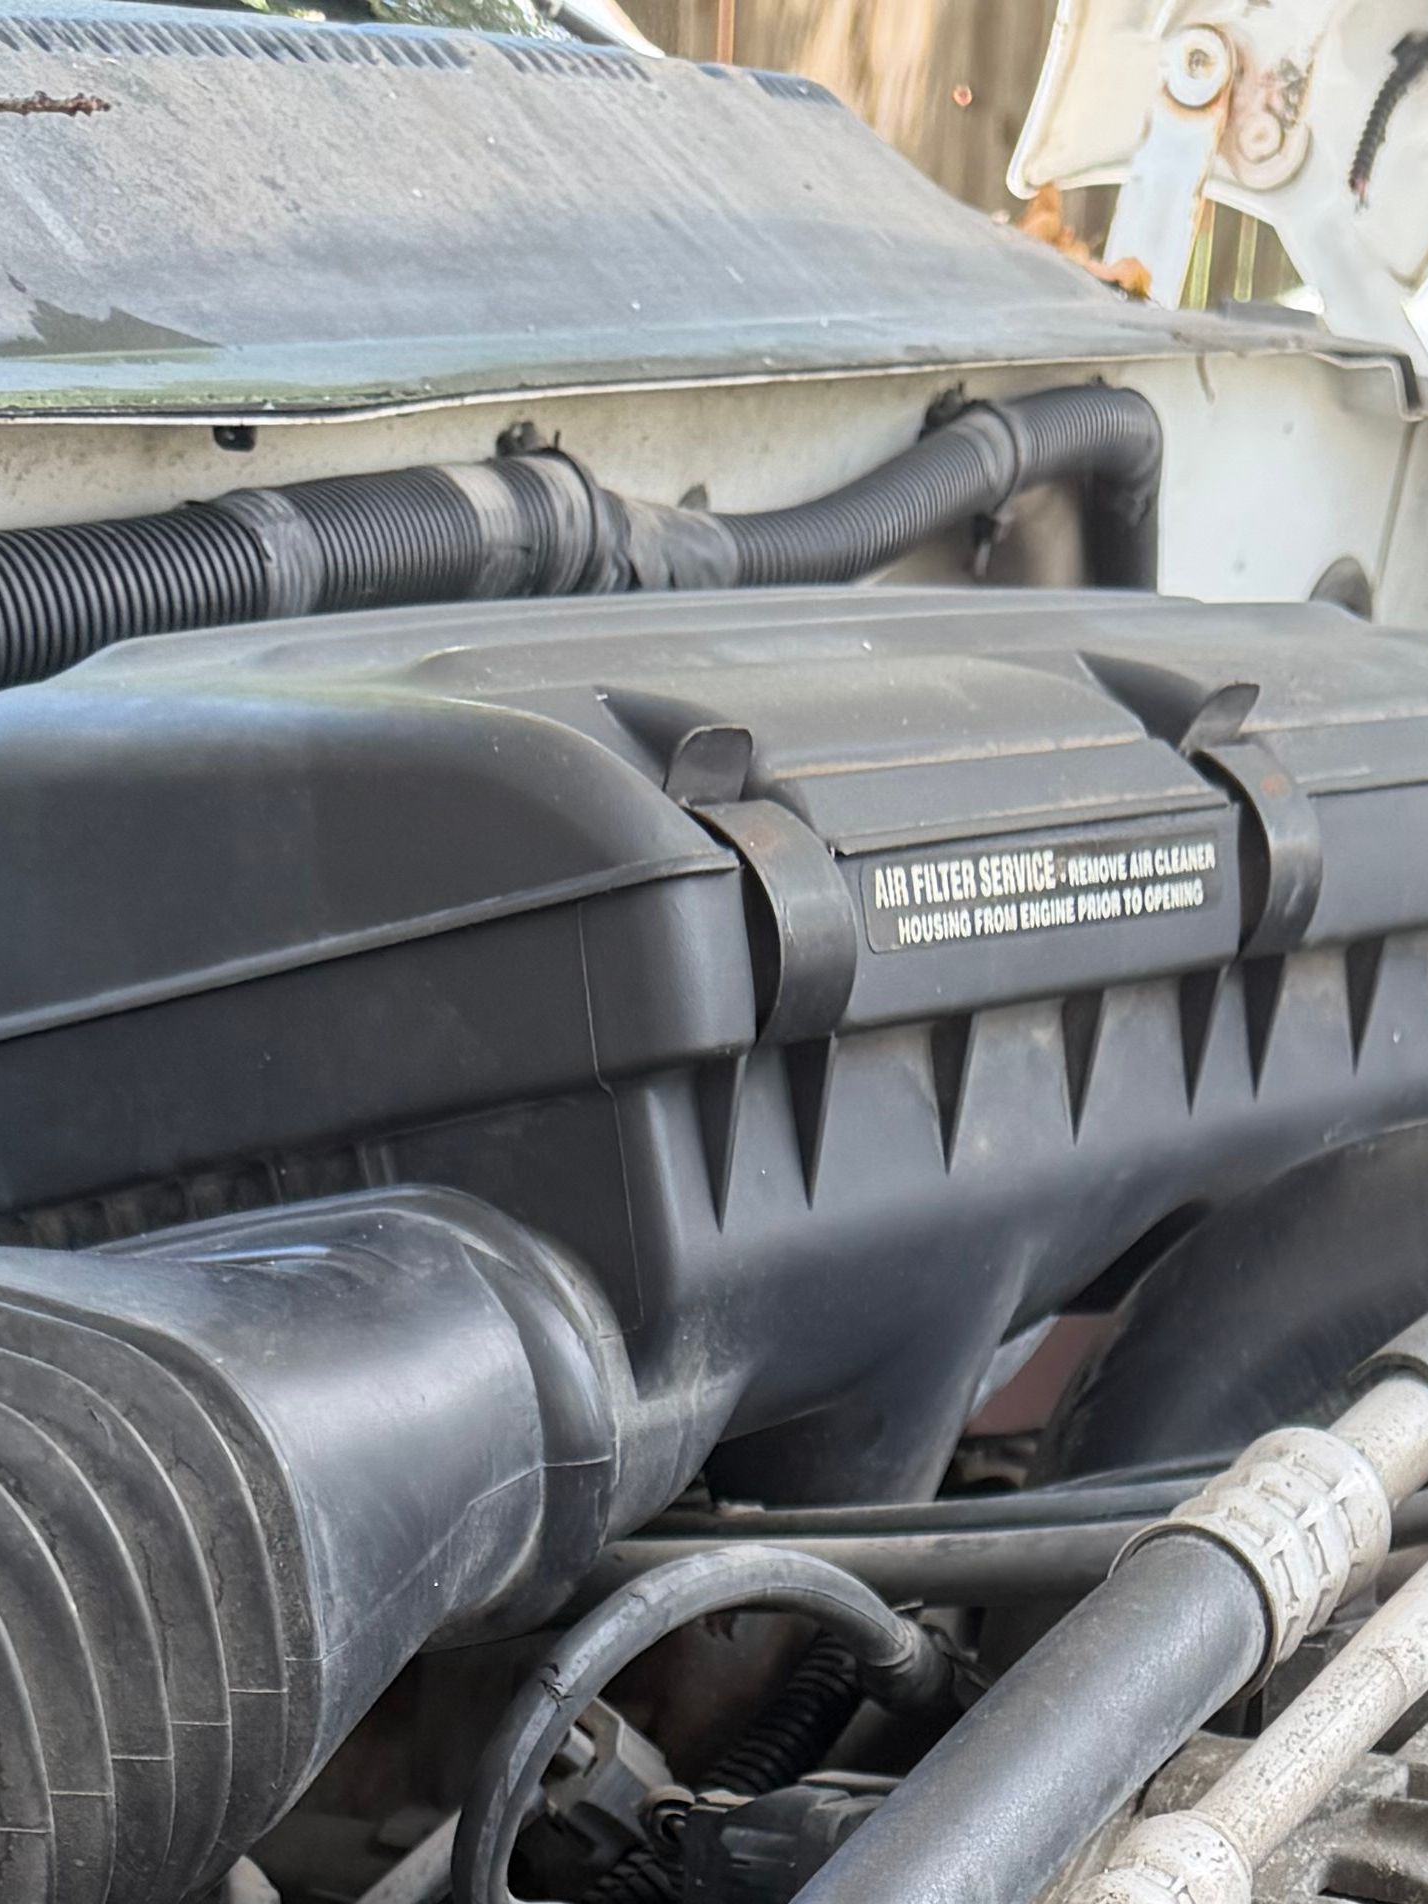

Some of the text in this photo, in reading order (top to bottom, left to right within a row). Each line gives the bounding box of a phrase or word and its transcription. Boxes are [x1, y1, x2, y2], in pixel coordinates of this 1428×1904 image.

[874, 865, 910, 909] AIR
[912, 856, 977, 902] FILTER
[978, 850, 1057, 898] SERVICE
[1068, 856, 1129, 888] REMOVE
[1130, 852, 1154, 881] AIR
[1155, 842, 1216, 876] CLEANER
[897, 880, 1205, 945] HOUSING FROM ENGINE PRIOR TO OPENING
